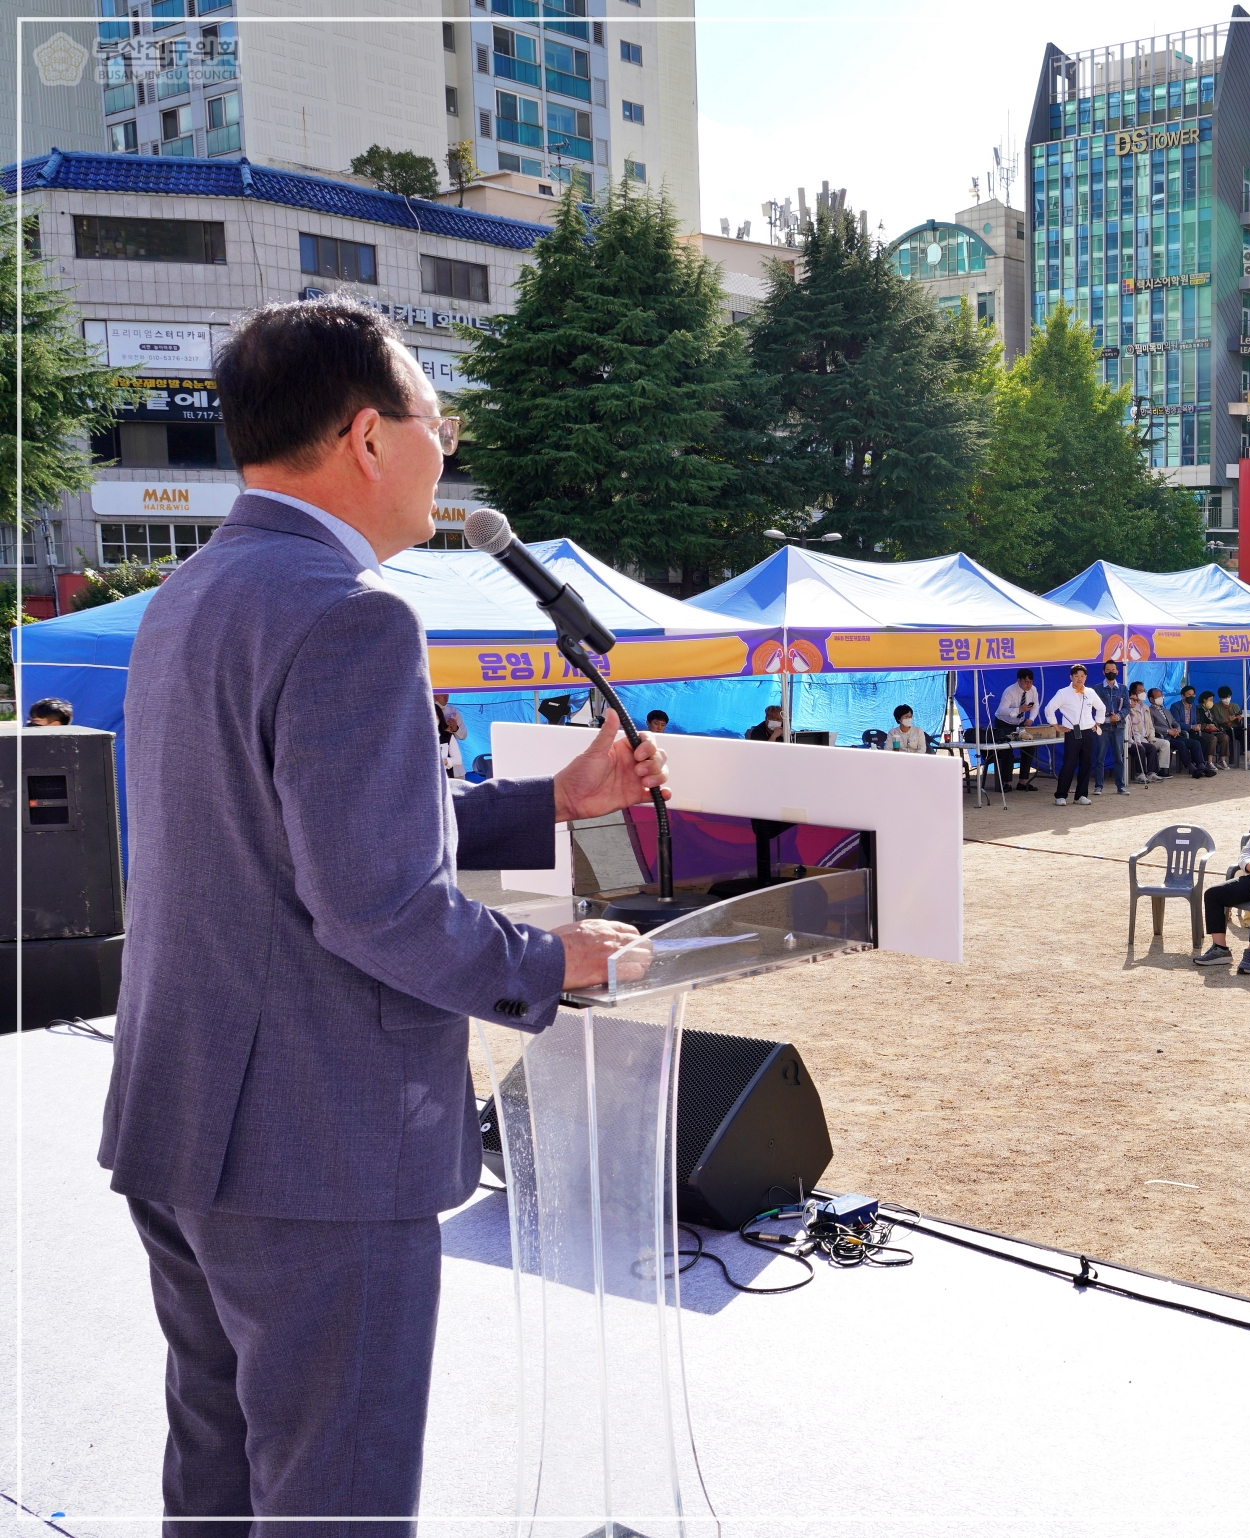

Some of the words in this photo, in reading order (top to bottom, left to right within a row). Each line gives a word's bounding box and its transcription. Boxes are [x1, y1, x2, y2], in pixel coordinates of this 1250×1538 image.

[1115, 129, 1147, 156] DS
[1150, 128, 1200, 149] TOWER
[1136, 274, 1188, 290] 렉시스어학원
[436, 309, 508, 338] 화이트
[183, 411, 195, 419] TEL
[197, 411, 223, 420] 717-3
[143, 489, 189, 502] MAIN
[939, 638, 971, 661] 운영
[985, 637, 1015, 659] 지원
[1218, 634, 1250, 653] 출연자
[478, 652, 534, 681] 운영
